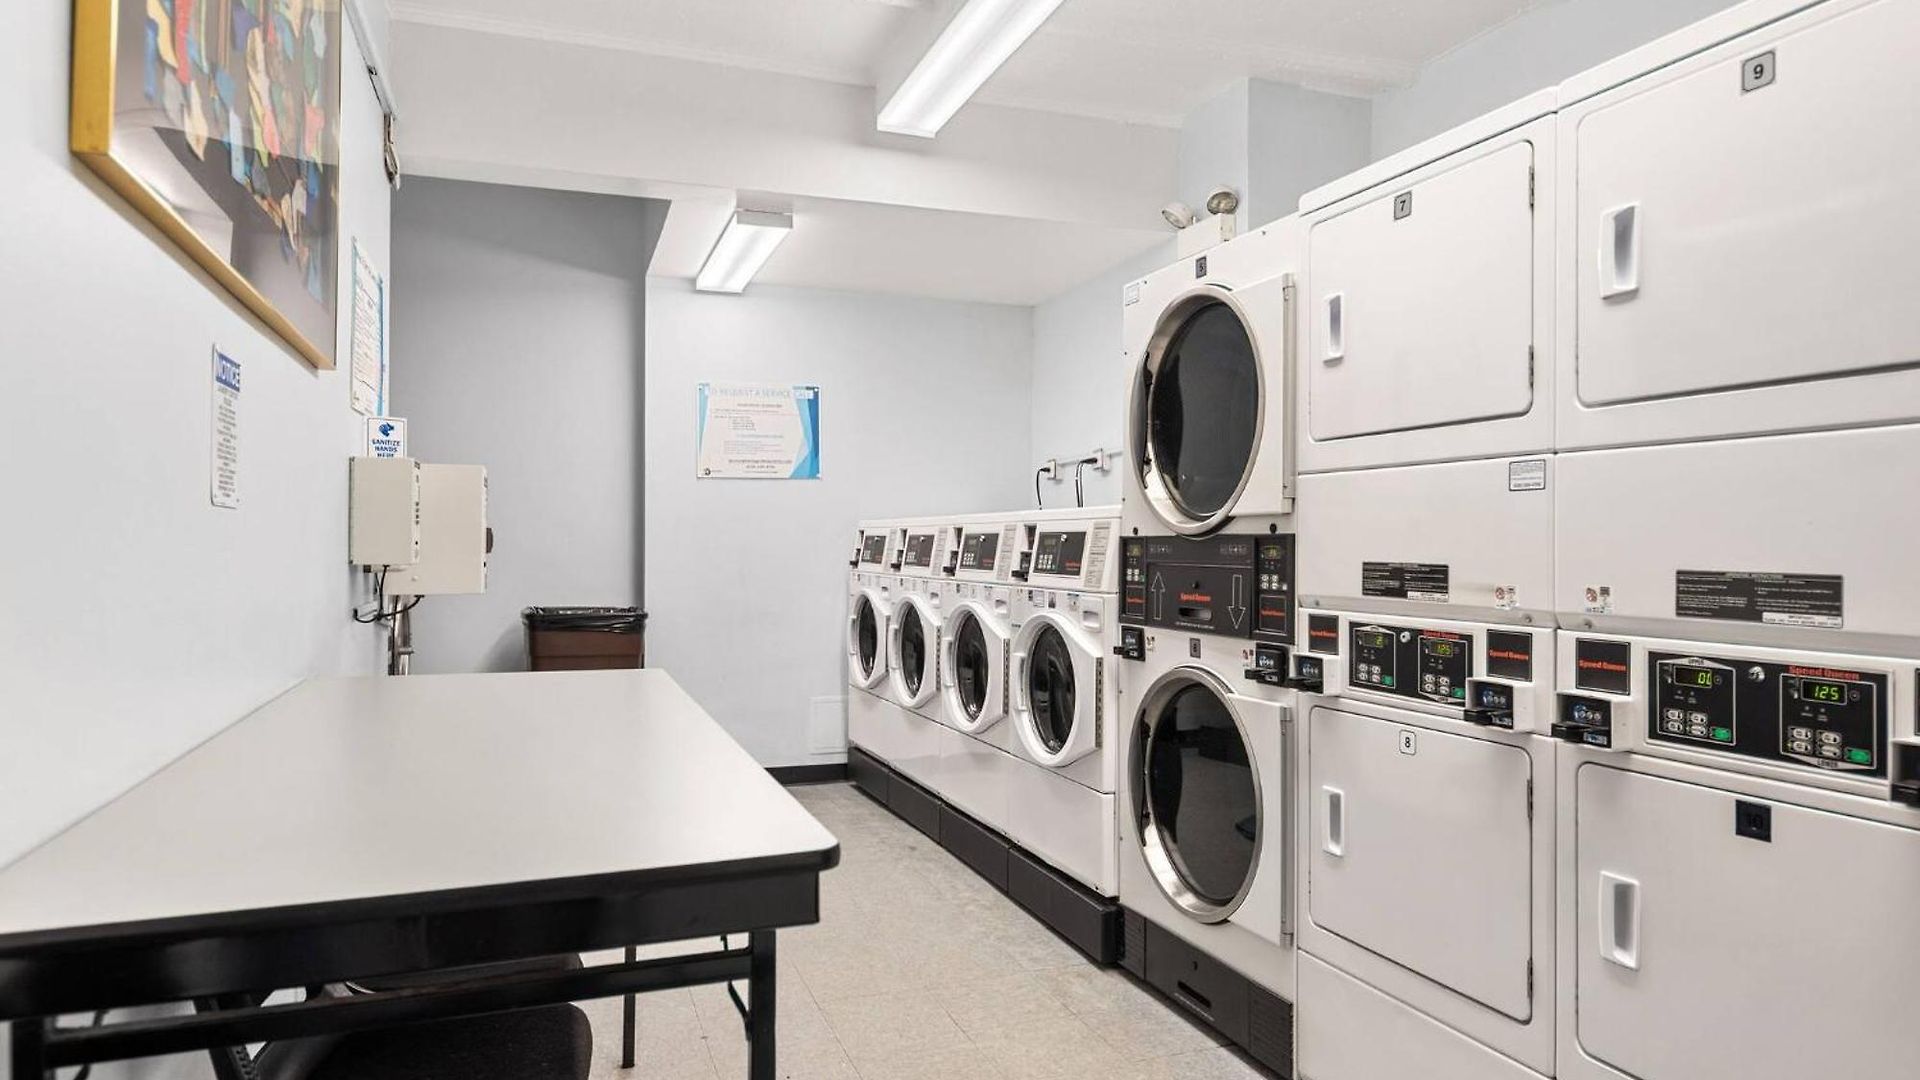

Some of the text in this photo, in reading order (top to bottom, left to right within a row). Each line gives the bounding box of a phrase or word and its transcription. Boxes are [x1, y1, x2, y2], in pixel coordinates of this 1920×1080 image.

[1753, 63, 1764, 80] 9
[1399, 199, 1407, 212] 7
[216, 357, 241, 388] NOTICE
[1489, 649, 1529, 661] Speed Queen
[1579, 659, 1626, 672] Speed Queen
[1788, 664, 1859, 681] Speed Queen
[1814, 684, 1839, 701] 125
[1404, 736, 1411, 748] 8
[1817, 760, 1839, 768] LOWER
